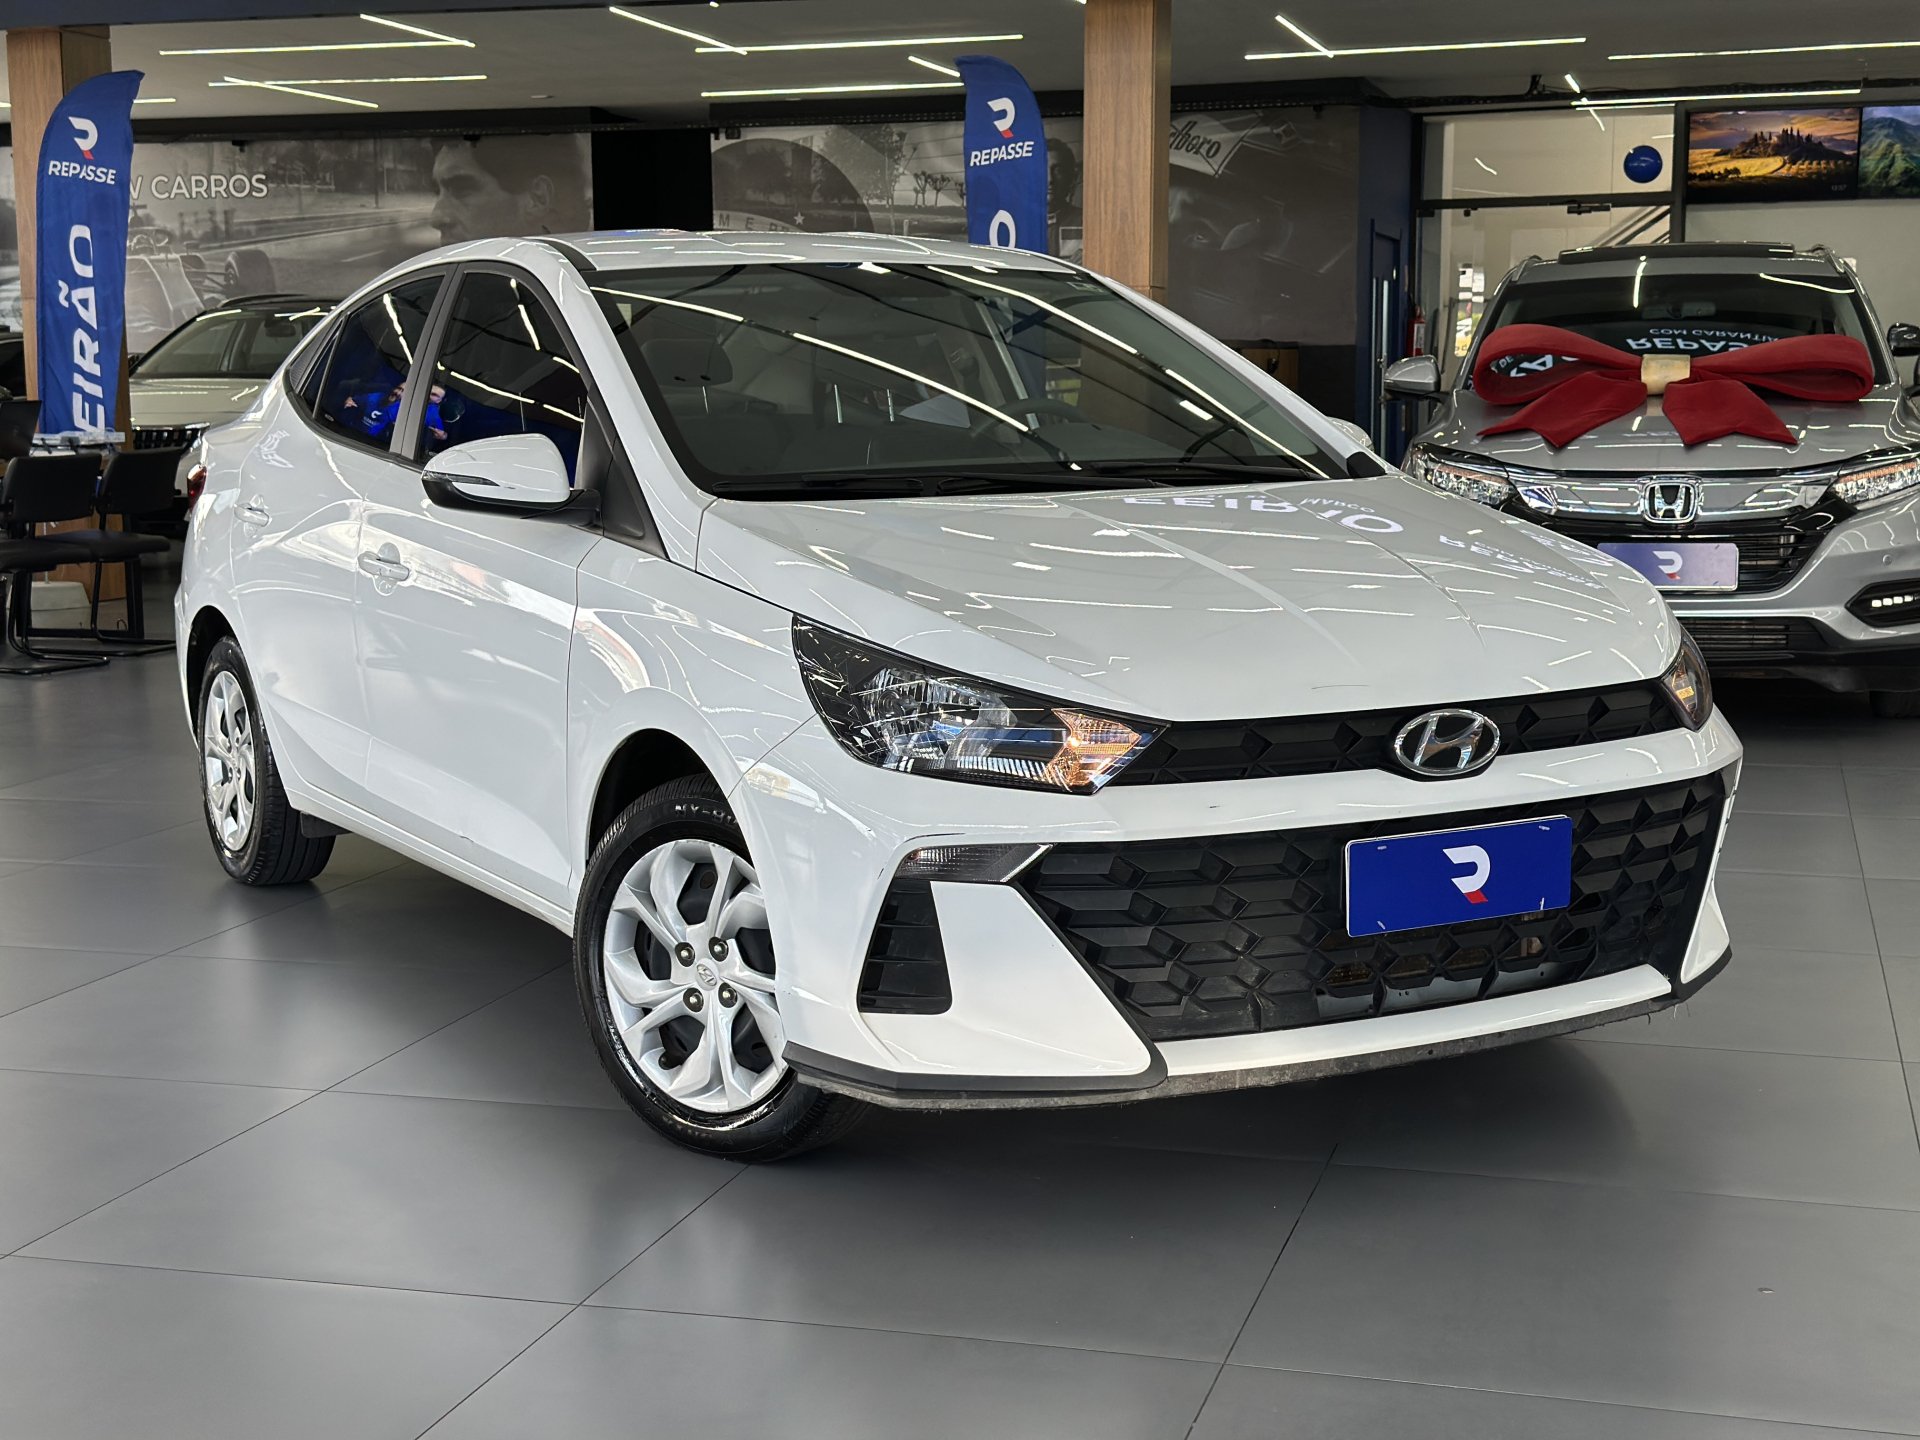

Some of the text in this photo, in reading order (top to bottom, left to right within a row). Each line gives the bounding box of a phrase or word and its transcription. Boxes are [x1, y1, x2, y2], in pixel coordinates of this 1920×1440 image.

[970, 141, 1034, 166] REPASSE
[48, 160, 116, 185] REPASSE
[151, 173, 268, 199] CARROS
